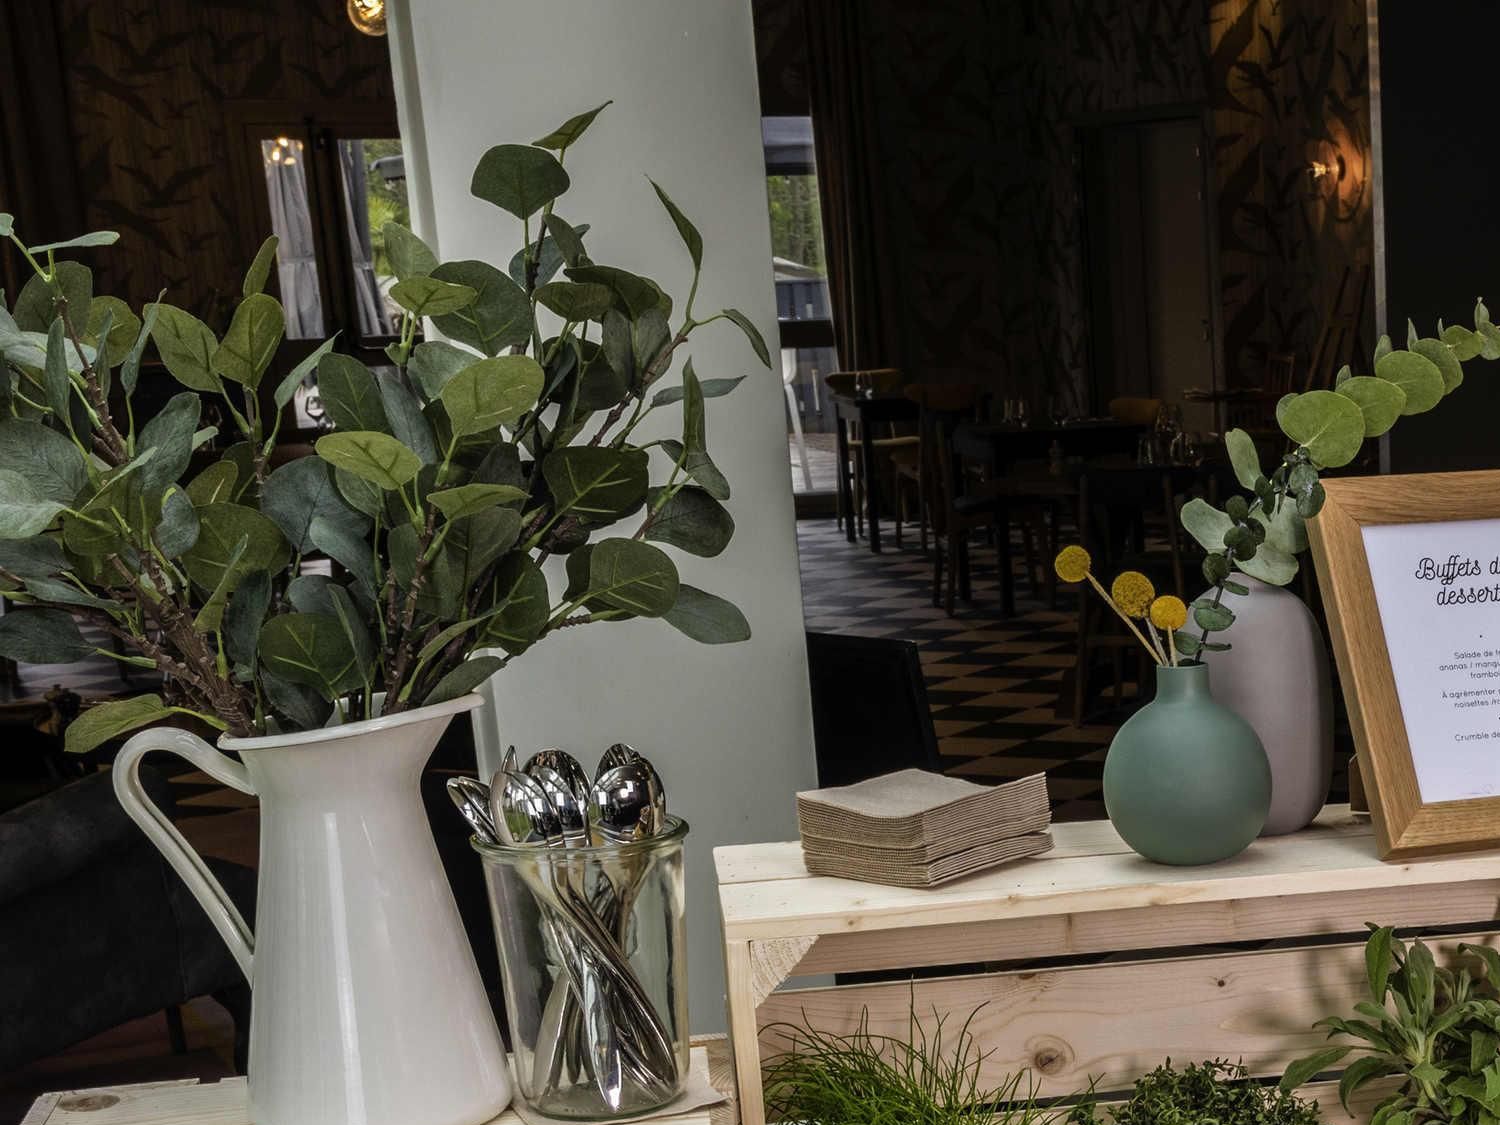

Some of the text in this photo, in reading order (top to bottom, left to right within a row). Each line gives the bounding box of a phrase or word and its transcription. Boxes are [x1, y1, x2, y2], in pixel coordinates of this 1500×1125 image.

[1415, 555, 1481, 585] Buffets
[1454, 650, 1482, 660] Salade
[1483, 650, 1494, 658] de
[1439, 663, 1468, 672] ananas
[1454, 699, 1489, 708] noisettes
[1454, 732, 1490, 742] Crumble
